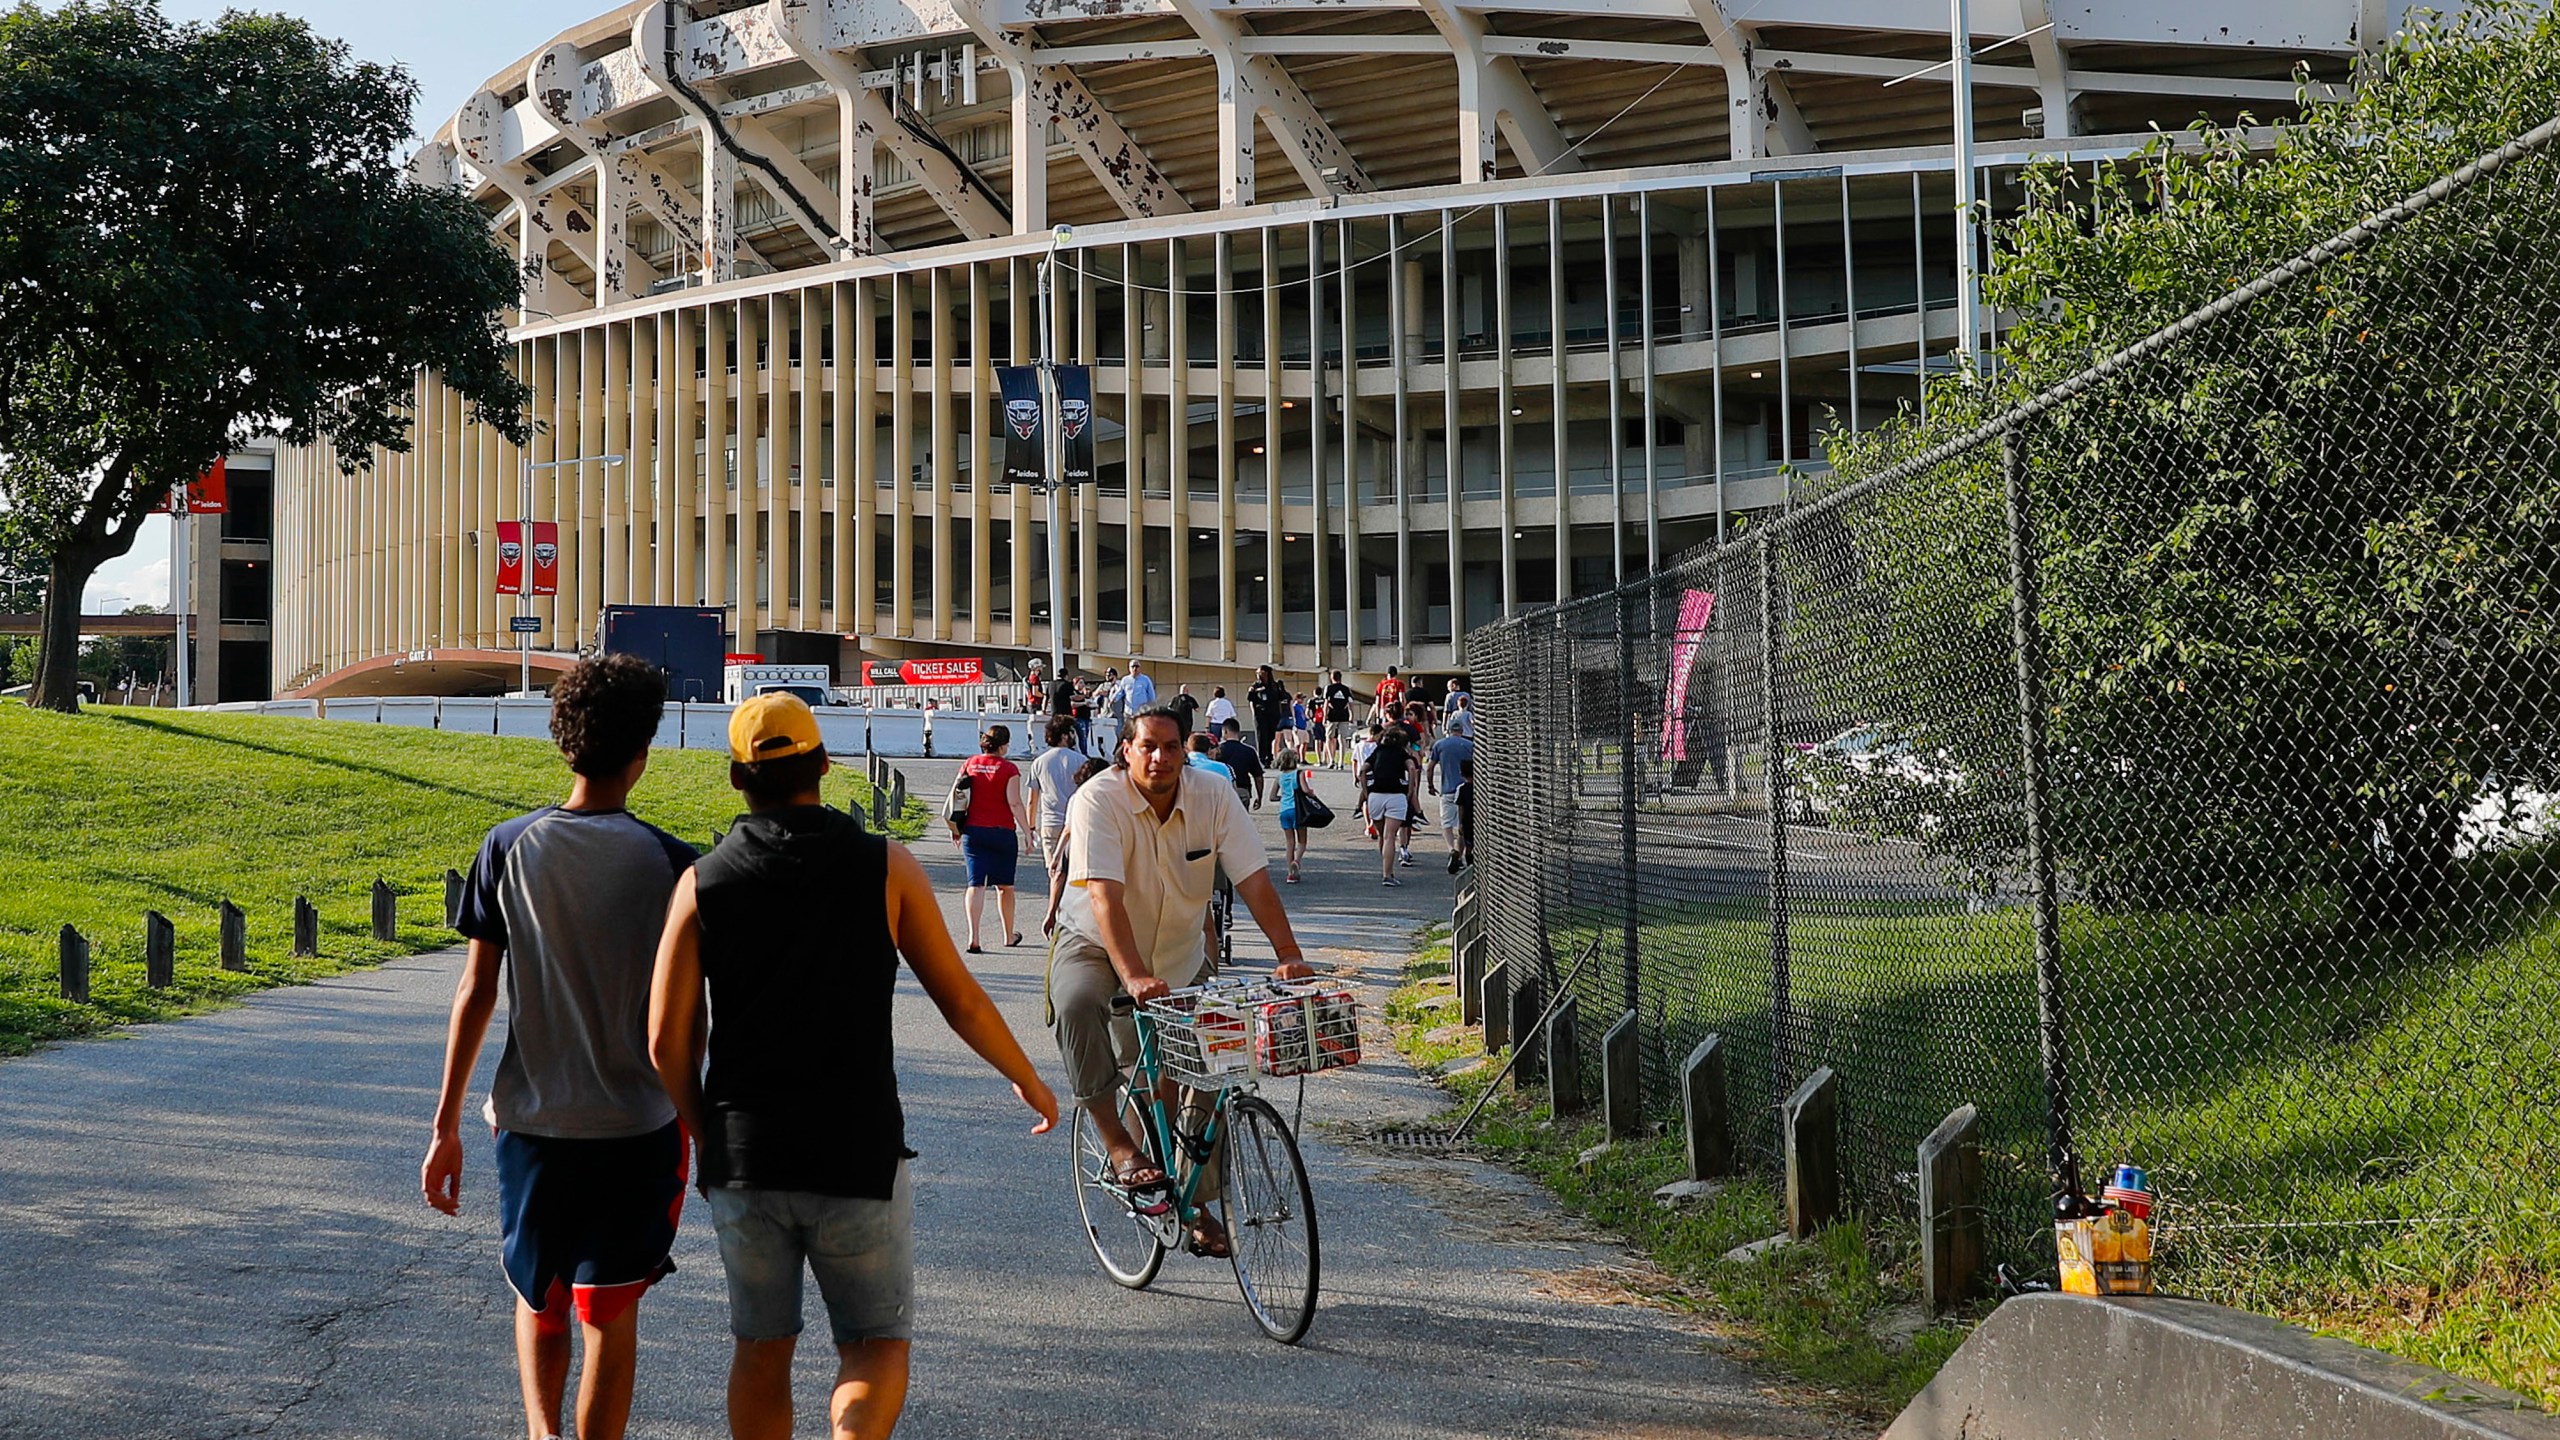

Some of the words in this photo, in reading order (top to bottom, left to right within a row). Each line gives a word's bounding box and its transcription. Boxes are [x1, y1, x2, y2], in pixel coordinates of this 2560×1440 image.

[1016, 469, 1039, 478] leidos
[408, 650, 425, 662] GATE
[427, 650, 433, 661] A
[884, 667, 898, 675] CALL
[911, 662, 945, 675] TICKET
[946, 661, 978, 674] SALES
